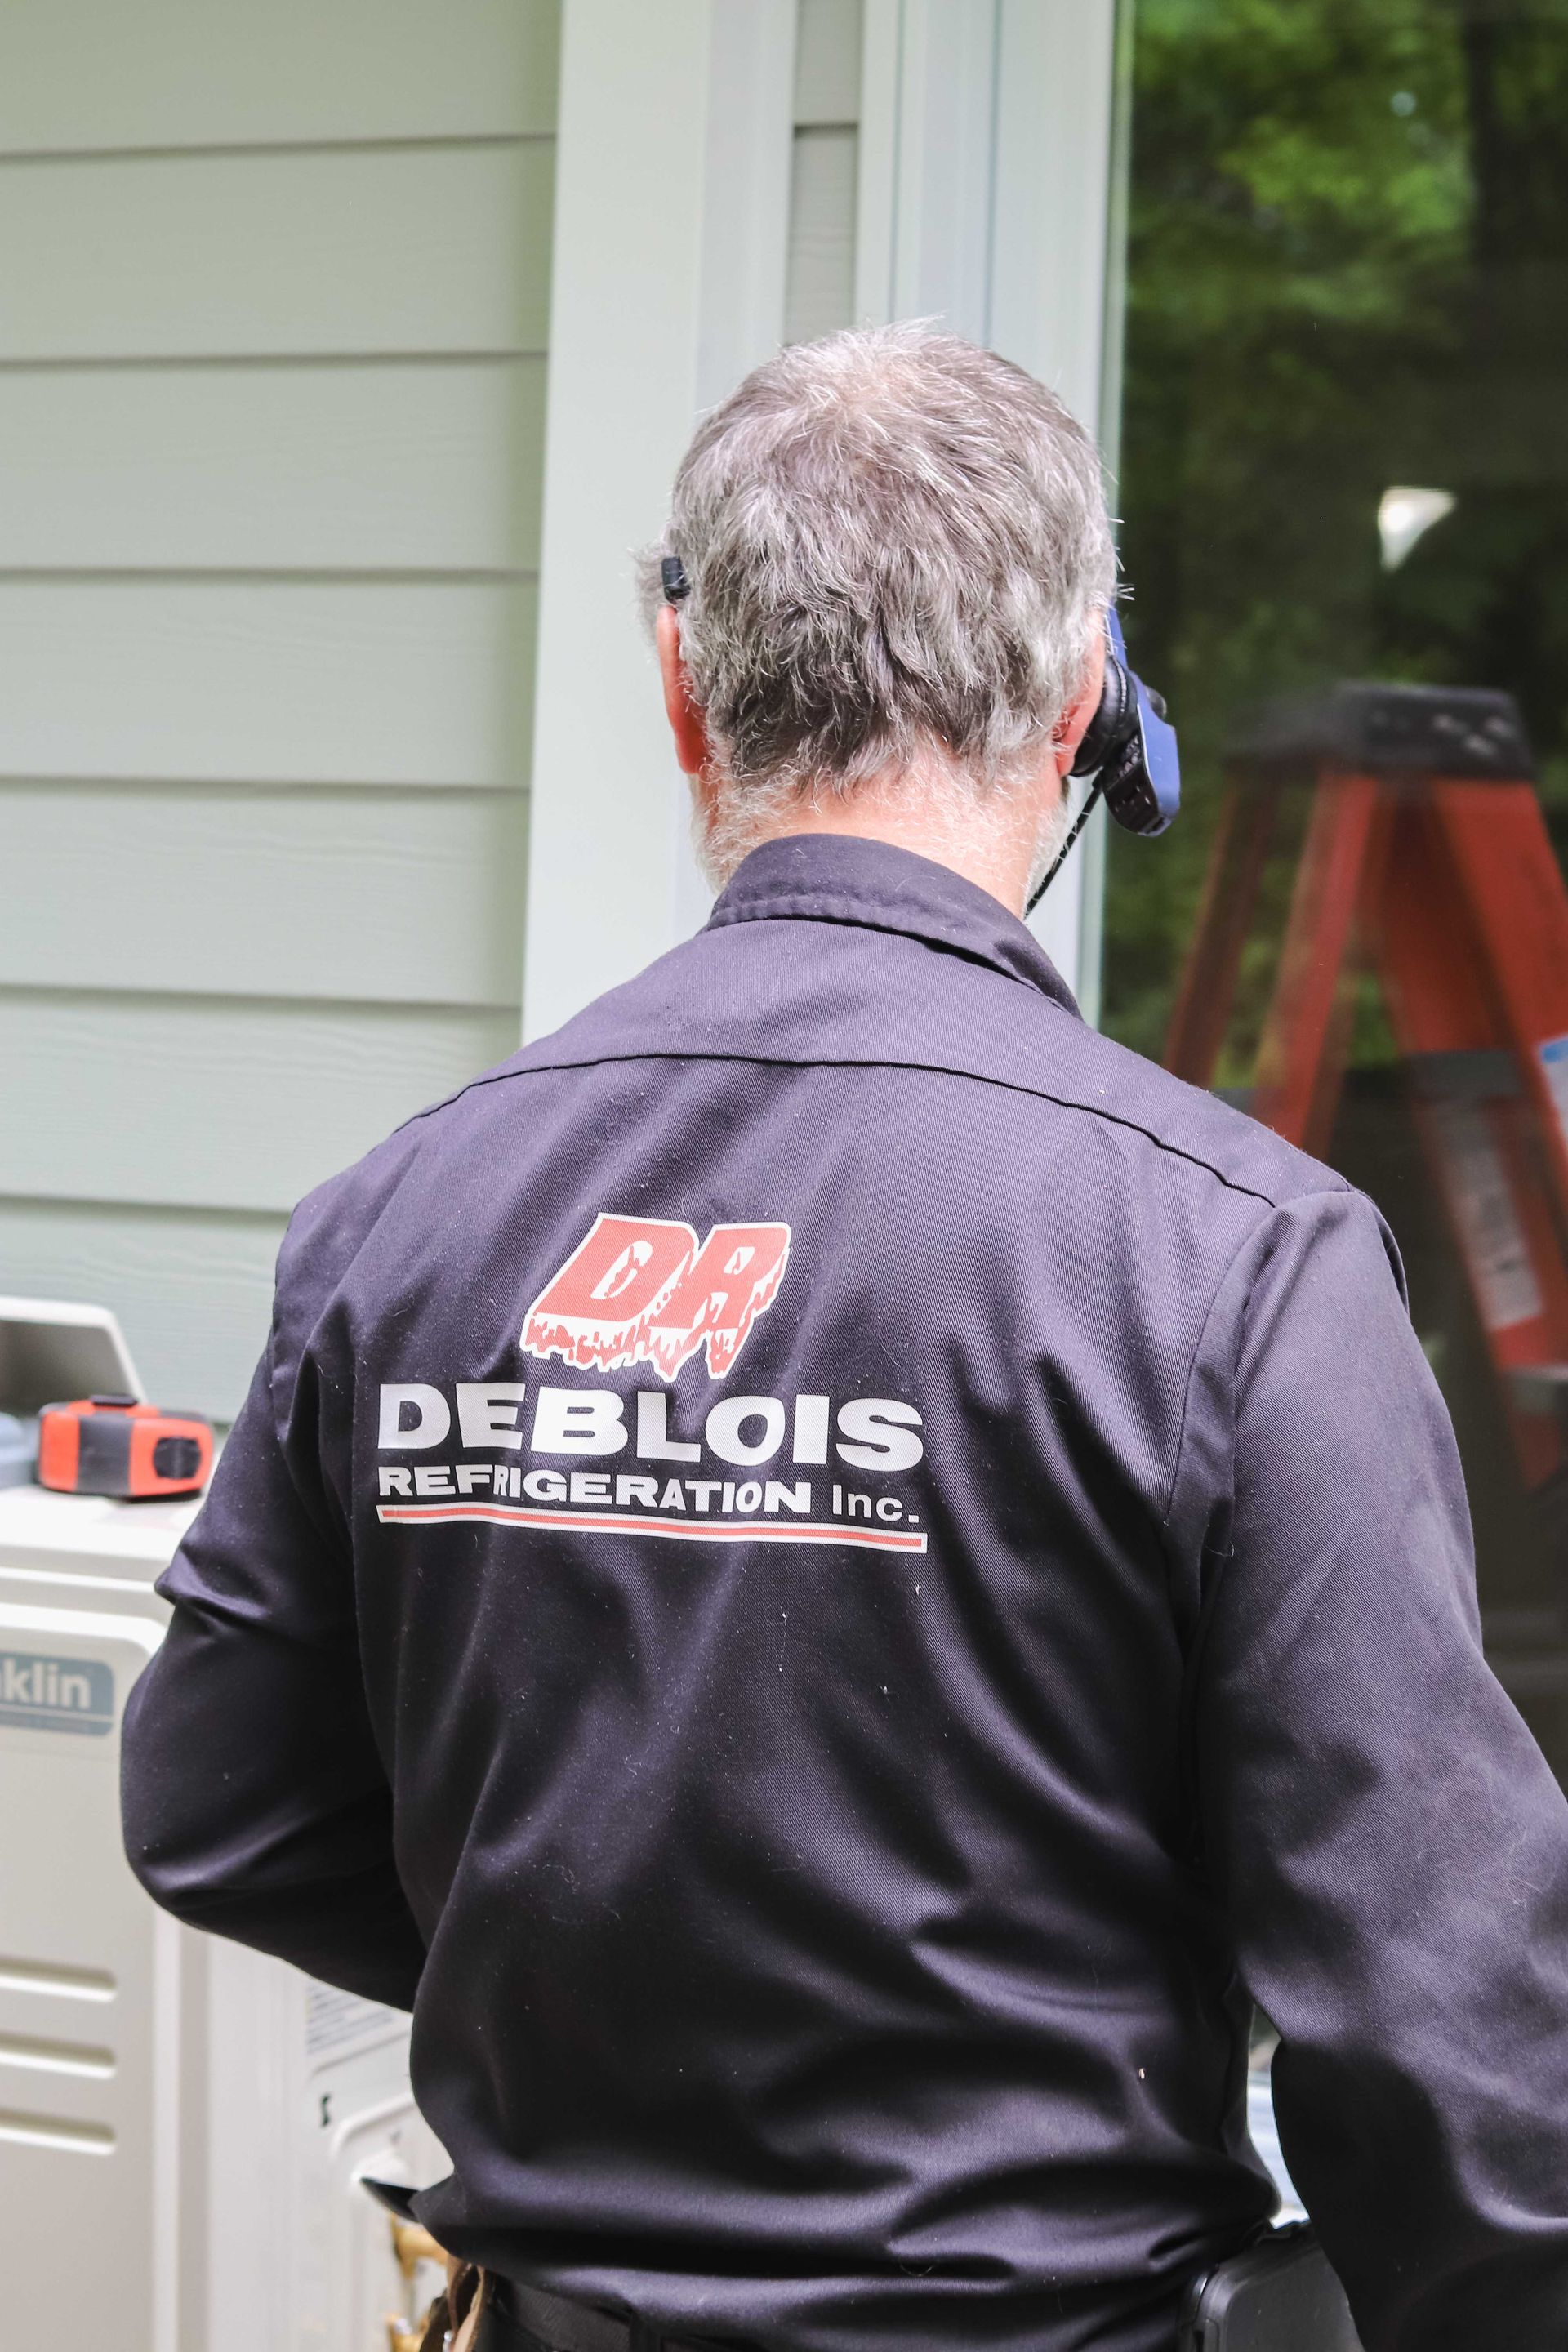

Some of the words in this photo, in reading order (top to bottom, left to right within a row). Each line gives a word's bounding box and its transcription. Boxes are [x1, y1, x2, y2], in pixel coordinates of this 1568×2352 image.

[520, 1212, 791, 1381] DR
[377, 1382, 924, 1472] DEBLOIS
[378, 1464, 812, 1514] REFRIGERATION
[832, 1485, 920, 1524] Inc.
[0, 1658, 91, 1710] klin
